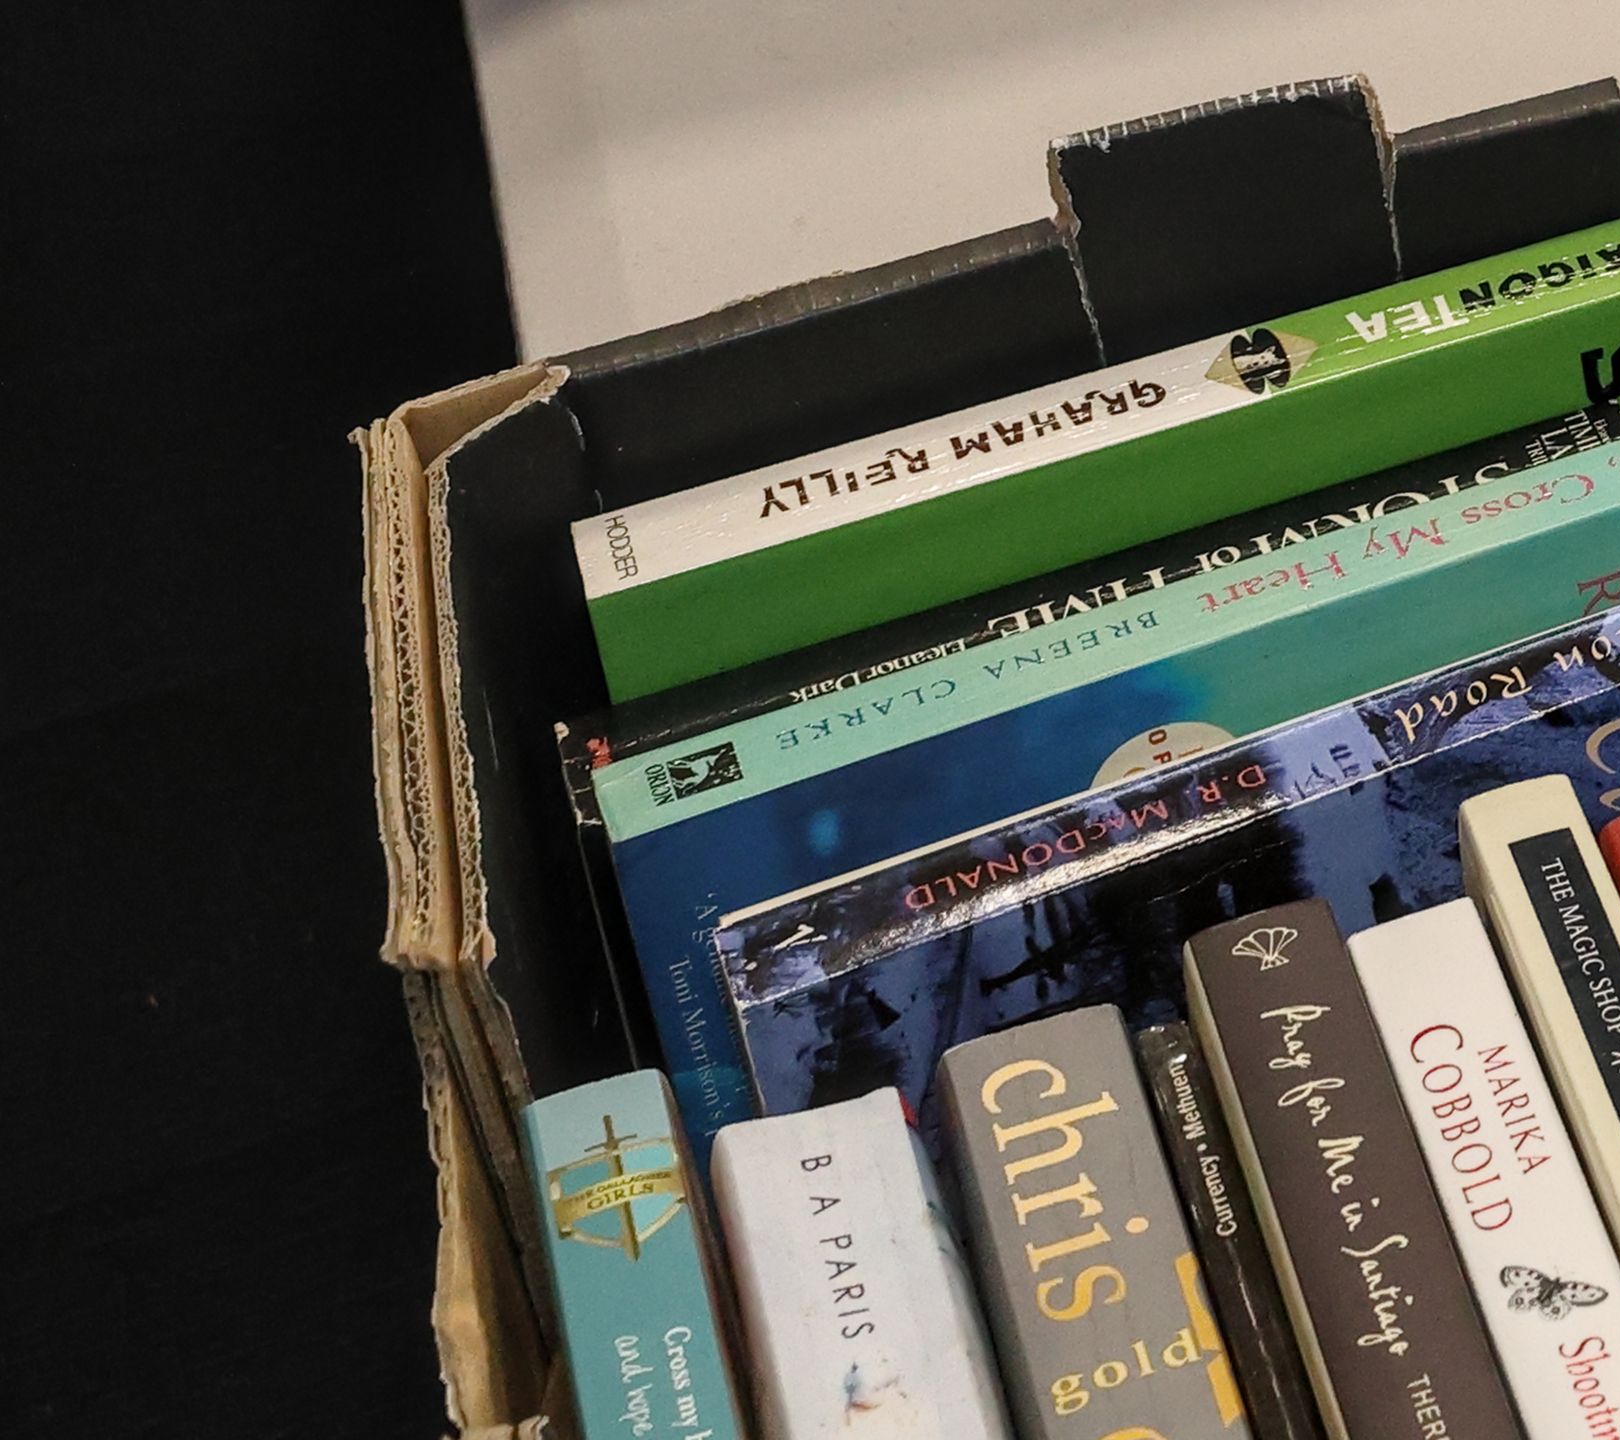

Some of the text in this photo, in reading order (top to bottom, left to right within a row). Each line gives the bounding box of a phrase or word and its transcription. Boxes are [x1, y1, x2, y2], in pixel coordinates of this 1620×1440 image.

[758, 380, 1167, 519] GRAHAM REILLY
[1360, 516, 1450, 562] My
[1460, 473, 1596, 527] Cross
[604, 514, 639, 582] HODDER
[1197, 548, 1349, 613] Heart
[776, 608, 1161, 751] BREENA CLARKE
[1396, 662, 1533, 749] Road
[1540, 857, 1572, 902] THE
[1559, 904, 1606, 979] MAGIC
[1176, 1059, 1211, 1137] Methuen
[1409, 1023, 1515, 1233] COBBOLD
[1477, 1042, 1553, 1177] MARIKA
[585, 1181, 657, 1212] GIRLS
[980, 1058, 1152, 1322] chris
[1198, 1155, 1239, 1237] Currency
[800, 1155, 876, 1340] B A PARIS
[1049, 1327, 1206, 1416] gold
